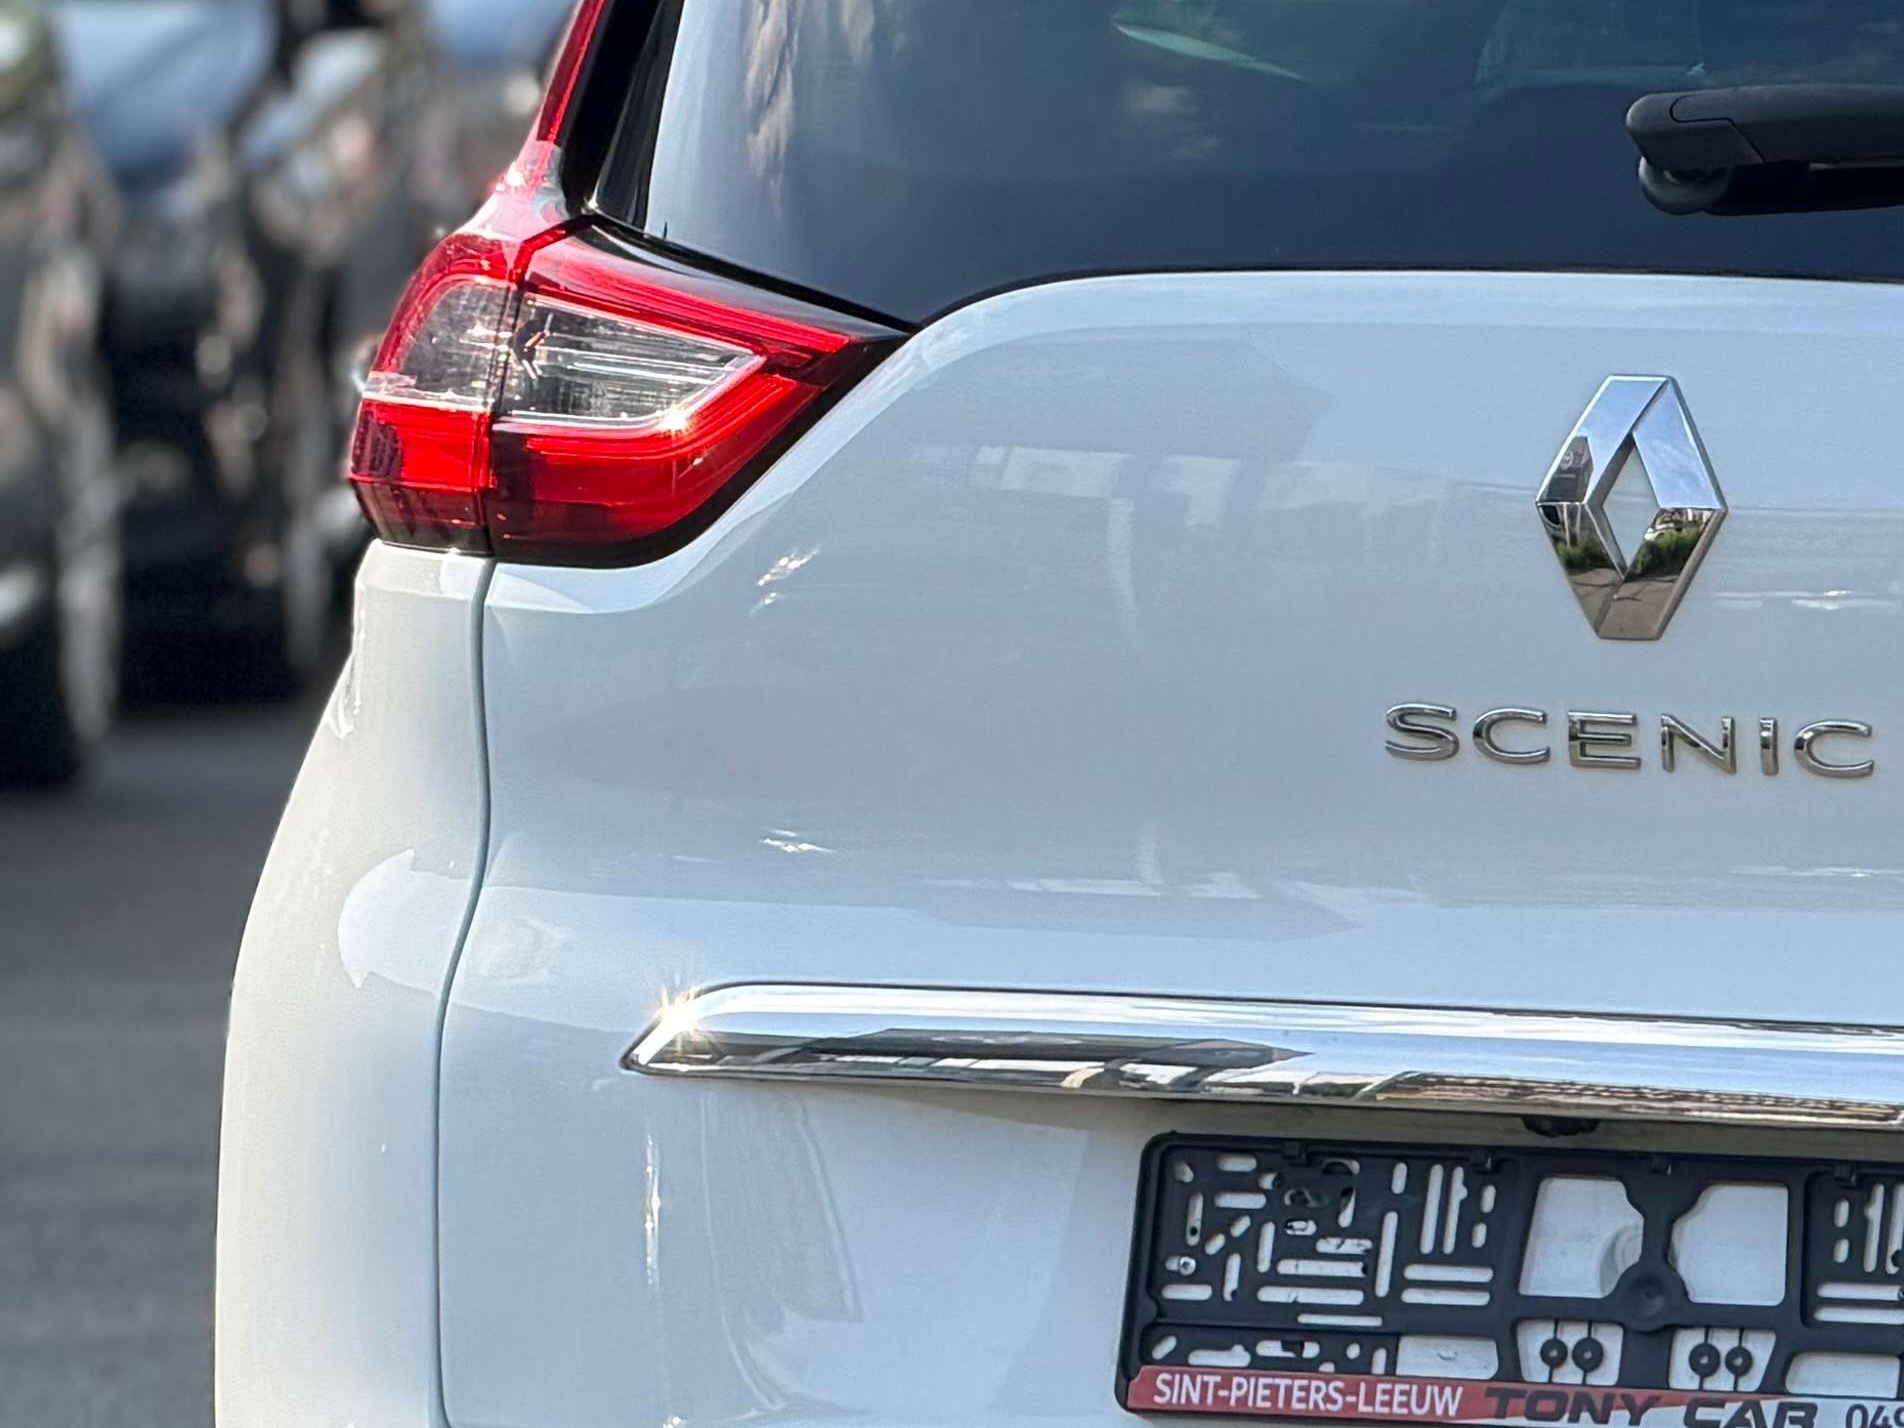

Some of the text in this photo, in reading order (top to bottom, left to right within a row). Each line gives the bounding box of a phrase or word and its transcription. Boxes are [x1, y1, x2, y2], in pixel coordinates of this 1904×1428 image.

[1385, 701, 1875, 779] SCENIC
[1152, 1371, 1464, 1418] SINT-PIETERS-LEEUW
[1483, 1386, 1662, 1427] TONY
